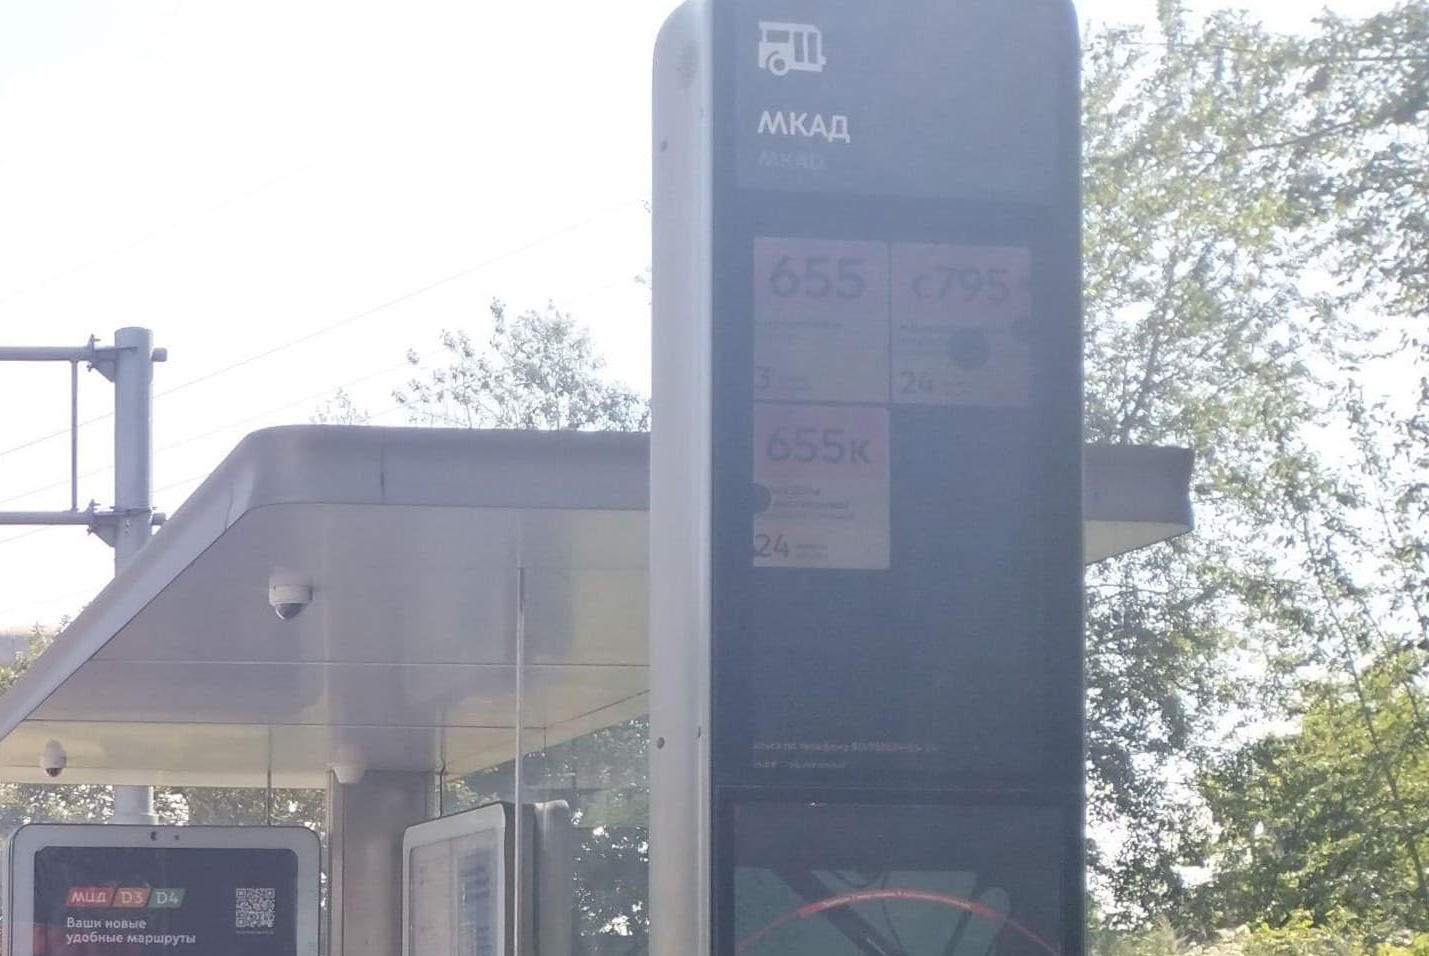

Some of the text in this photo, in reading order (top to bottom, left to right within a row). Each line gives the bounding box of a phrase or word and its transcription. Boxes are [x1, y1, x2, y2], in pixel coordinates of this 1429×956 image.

[757, 109, 851, 144] МКАД
[769, 254, 868, 299] 655
[755, 533, 790, 560] 24
[121, 891, 144, 904] D3
[155, 891, 179, 904] D4
[66, 917, 147, 929] Ваши новые
[66, 932, 196, 946] удобные маршруты
